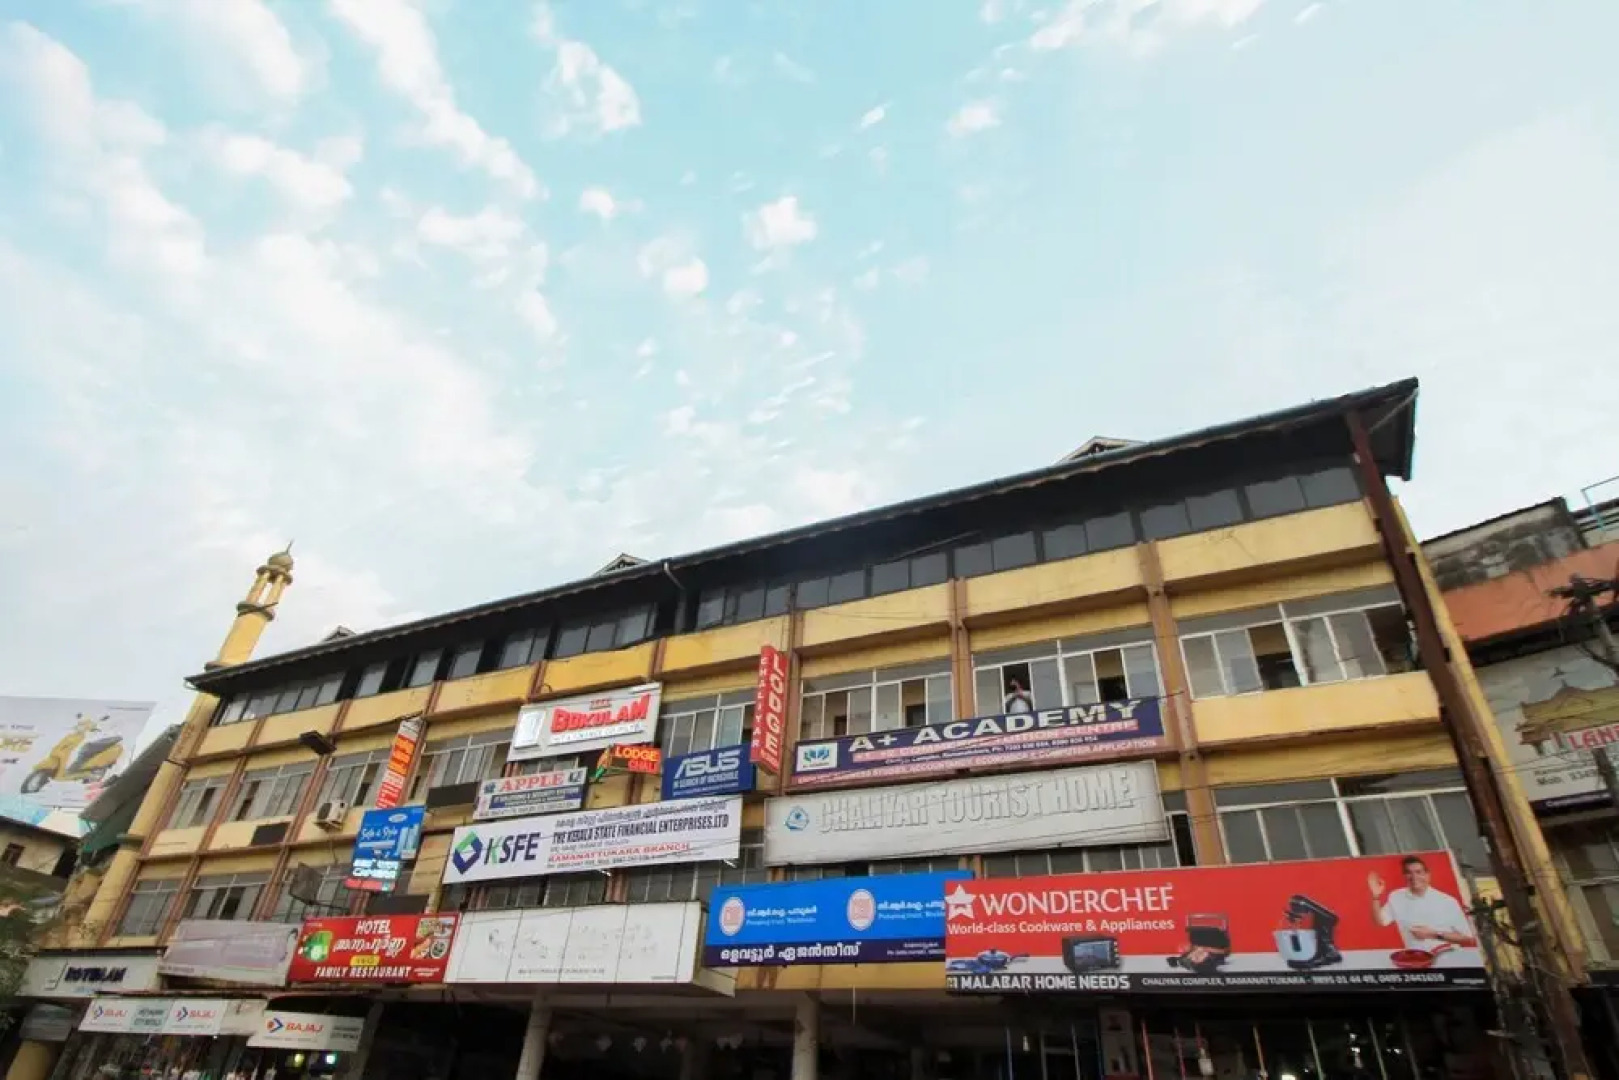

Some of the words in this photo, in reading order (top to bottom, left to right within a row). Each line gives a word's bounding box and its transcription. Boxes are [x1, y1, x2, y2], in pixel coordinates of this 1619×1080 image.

[764, 653, 785, 756] LODGE
[849, 734, 898, 752] A+
[913, 699, 1142, 744] ACADEMY
[614, 744, 660, 762] LODGE
[674, 749, 741, 780] ASUS
[501, 772, 565, 792] APPLE
[931, 779, 1043, 824] TOURIST
[1053, 770, 1135, 812] HOME
[552, 832, 567, 845] THE
[567, 828, 594, 843] KERALA
[594, 825, 616, 840] STATE
[616, 821, 657, 838] FINANCIAL
[484, 831, 541, 866] KSFE
[644, 841, 691, 854] BRANCH
[979, 886, 1174, 916] WONDERCHEF
[355, 919, 391, 935] HOTEL
[947, 921, 1016, 935] World-class
[1019, 920, 1082, 934] Cookware
[1086, 919, 1097, 931] &
[1100, 917, 1175, 934] Appliances
[314, 966, 346, 979] FAMILY
[349, 965, 412, 979] RESTAURANT
[960, 975, 1032, 990] MALABAR
[1035, 975, 1081, 989] HOME
[1084, 974, 1131, 990] NEEDS
[285, 1023, 326, 1034] BAJAJ
